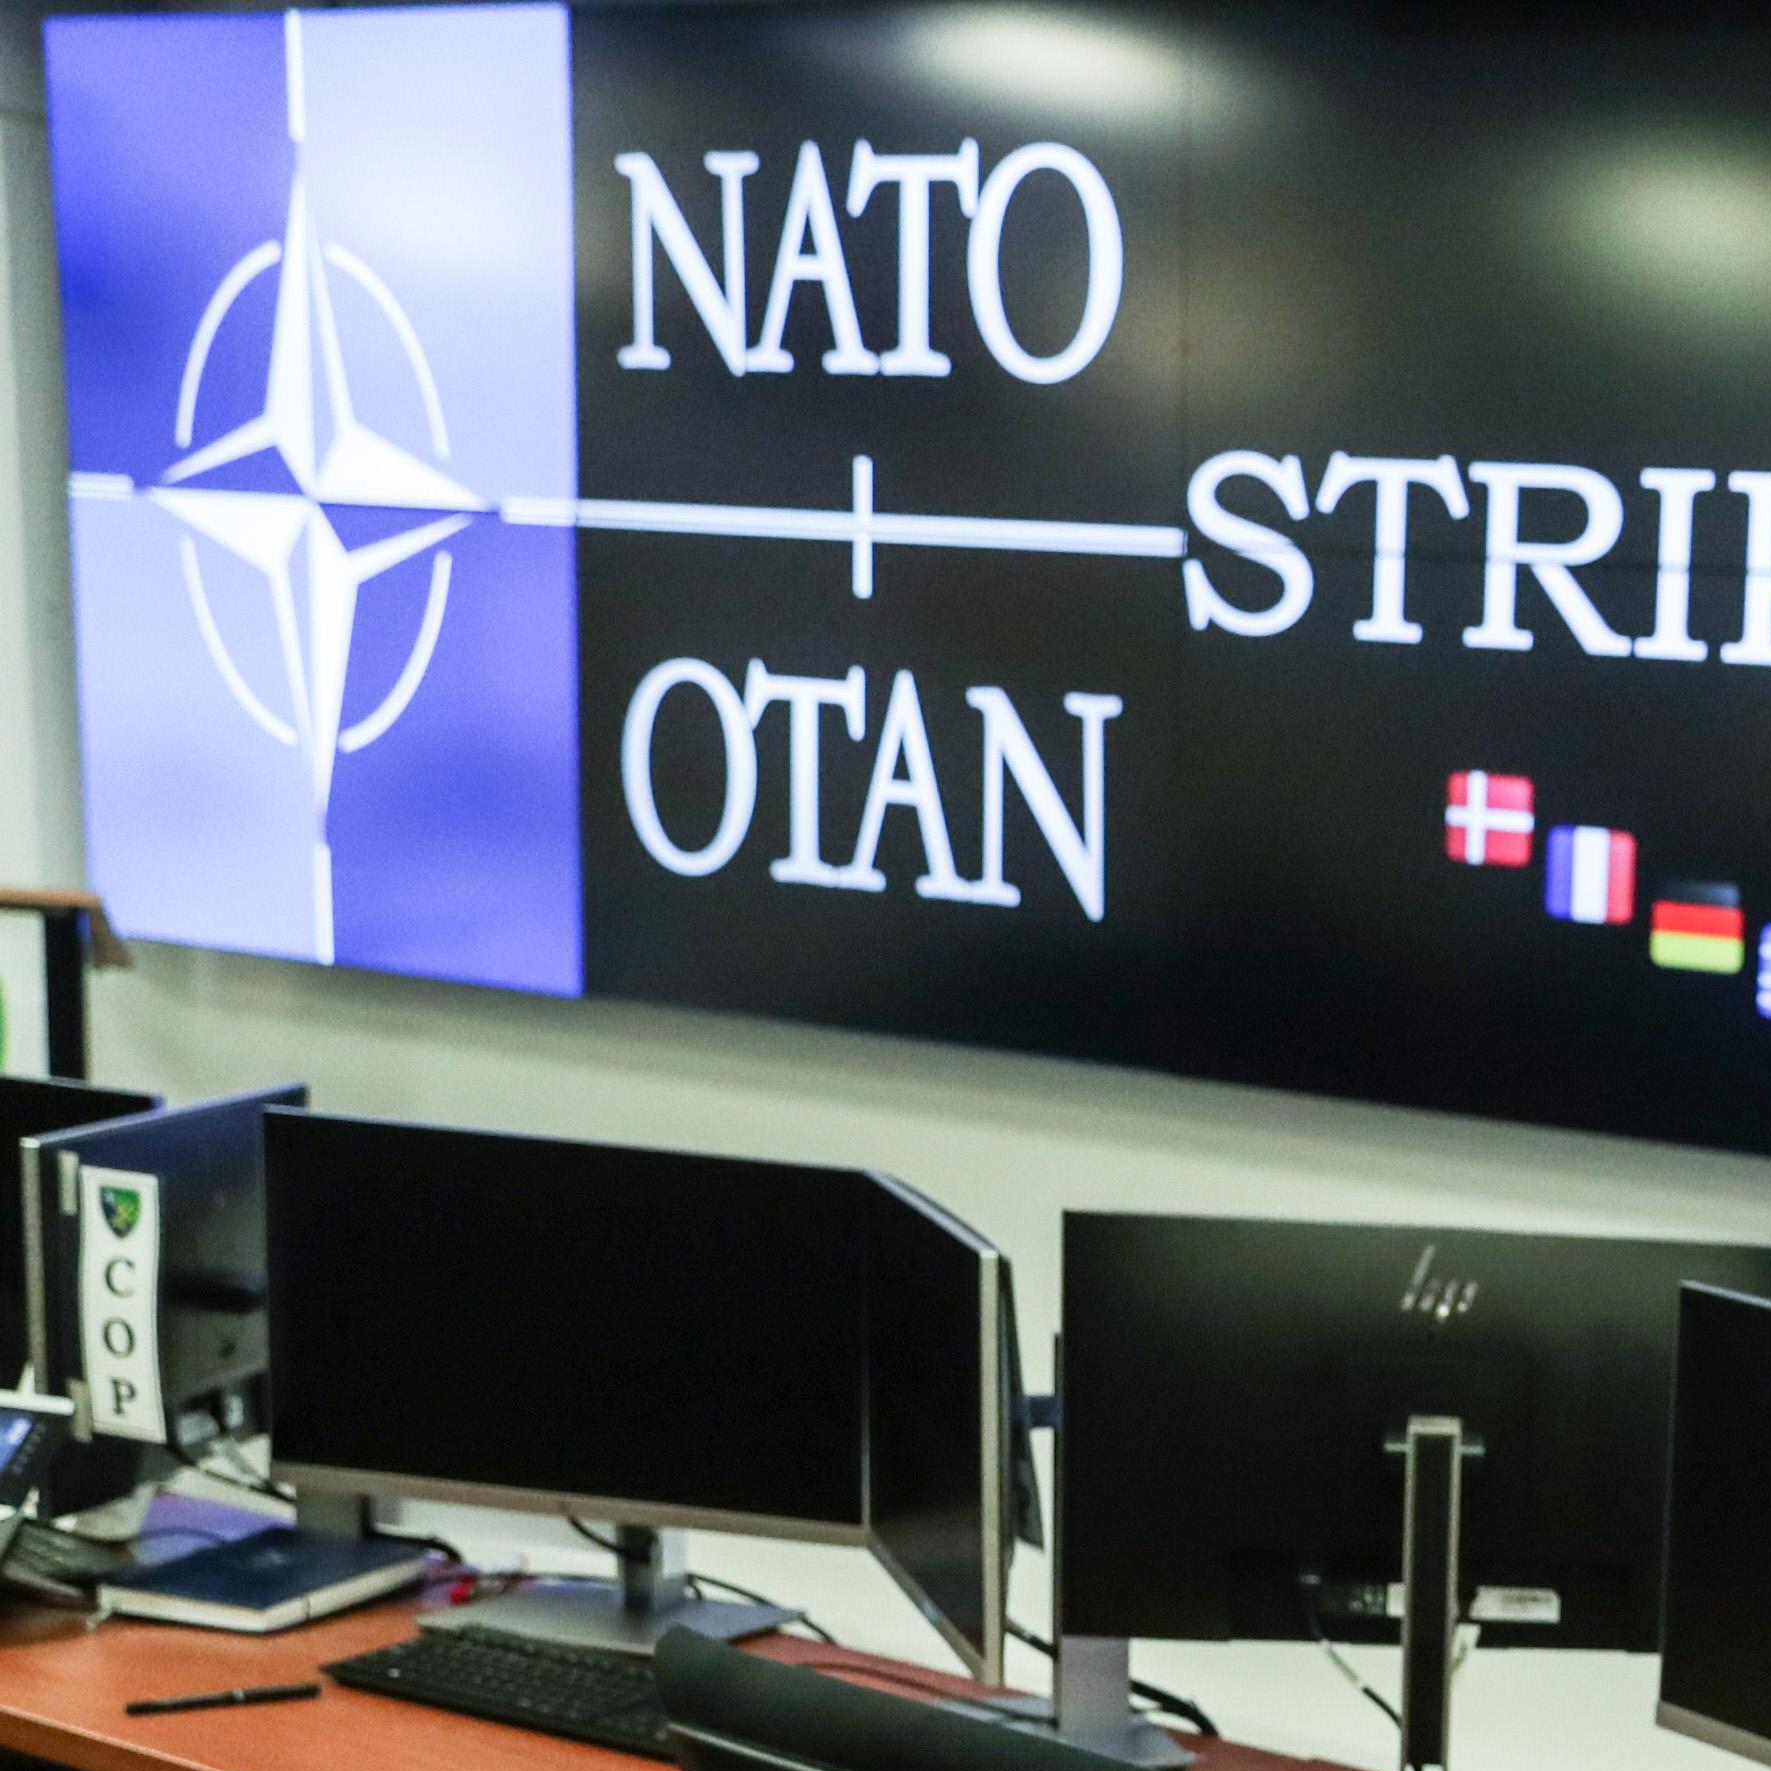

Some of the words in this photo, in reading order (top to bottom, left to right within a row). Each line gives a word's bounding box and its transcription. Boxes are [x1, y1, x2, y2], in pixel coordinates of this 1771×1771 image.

[615, 137, 1125, 386] NATO
[620, 658, 1124, 923] OTAN
[103, 1255, 136, 1416] COP
